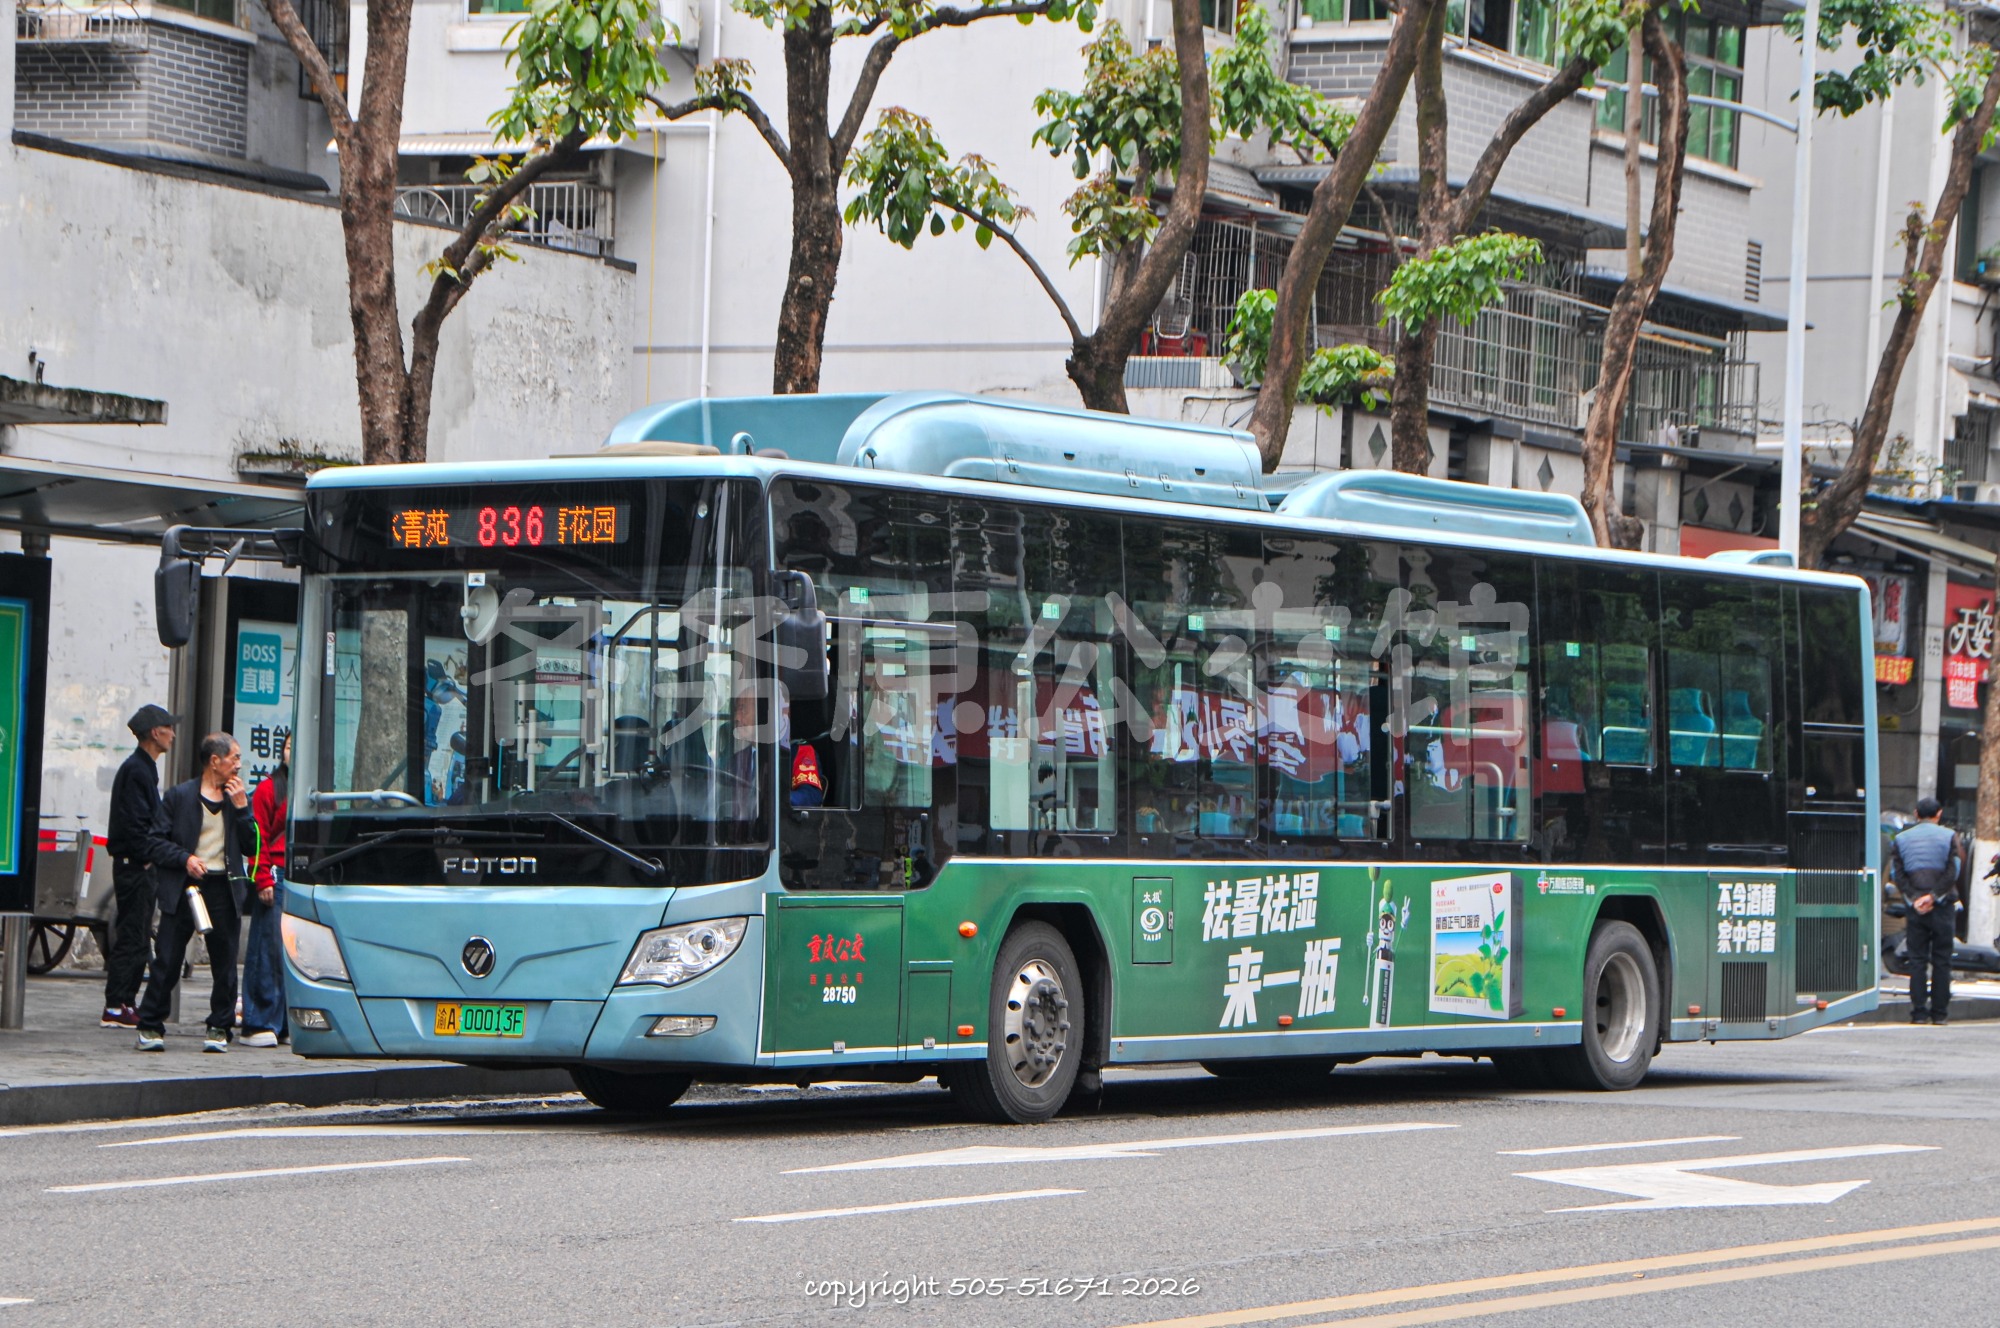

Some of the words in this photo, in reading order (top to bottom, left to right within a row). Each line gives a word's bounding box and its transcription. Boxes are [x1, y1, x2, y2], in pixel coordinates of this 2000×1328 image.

[478, 506, 544, 546] 836
[242, 643, 277, 664] BOSS
[240, 668, 276, 695] 直聘
[443, 856, 537, 874] FOTON
[1201, 872, 1320, 942] 祛暑祛湿
[1717, 882, 1777, 916] 不含酒精
[807, 933, 866, 963] 重庆公交
[1717, 919, 1777, 954] 家中常备
[822, 985, 857, 1003] 28750
[1219, 937, 1342, 1028] 来一瓶
